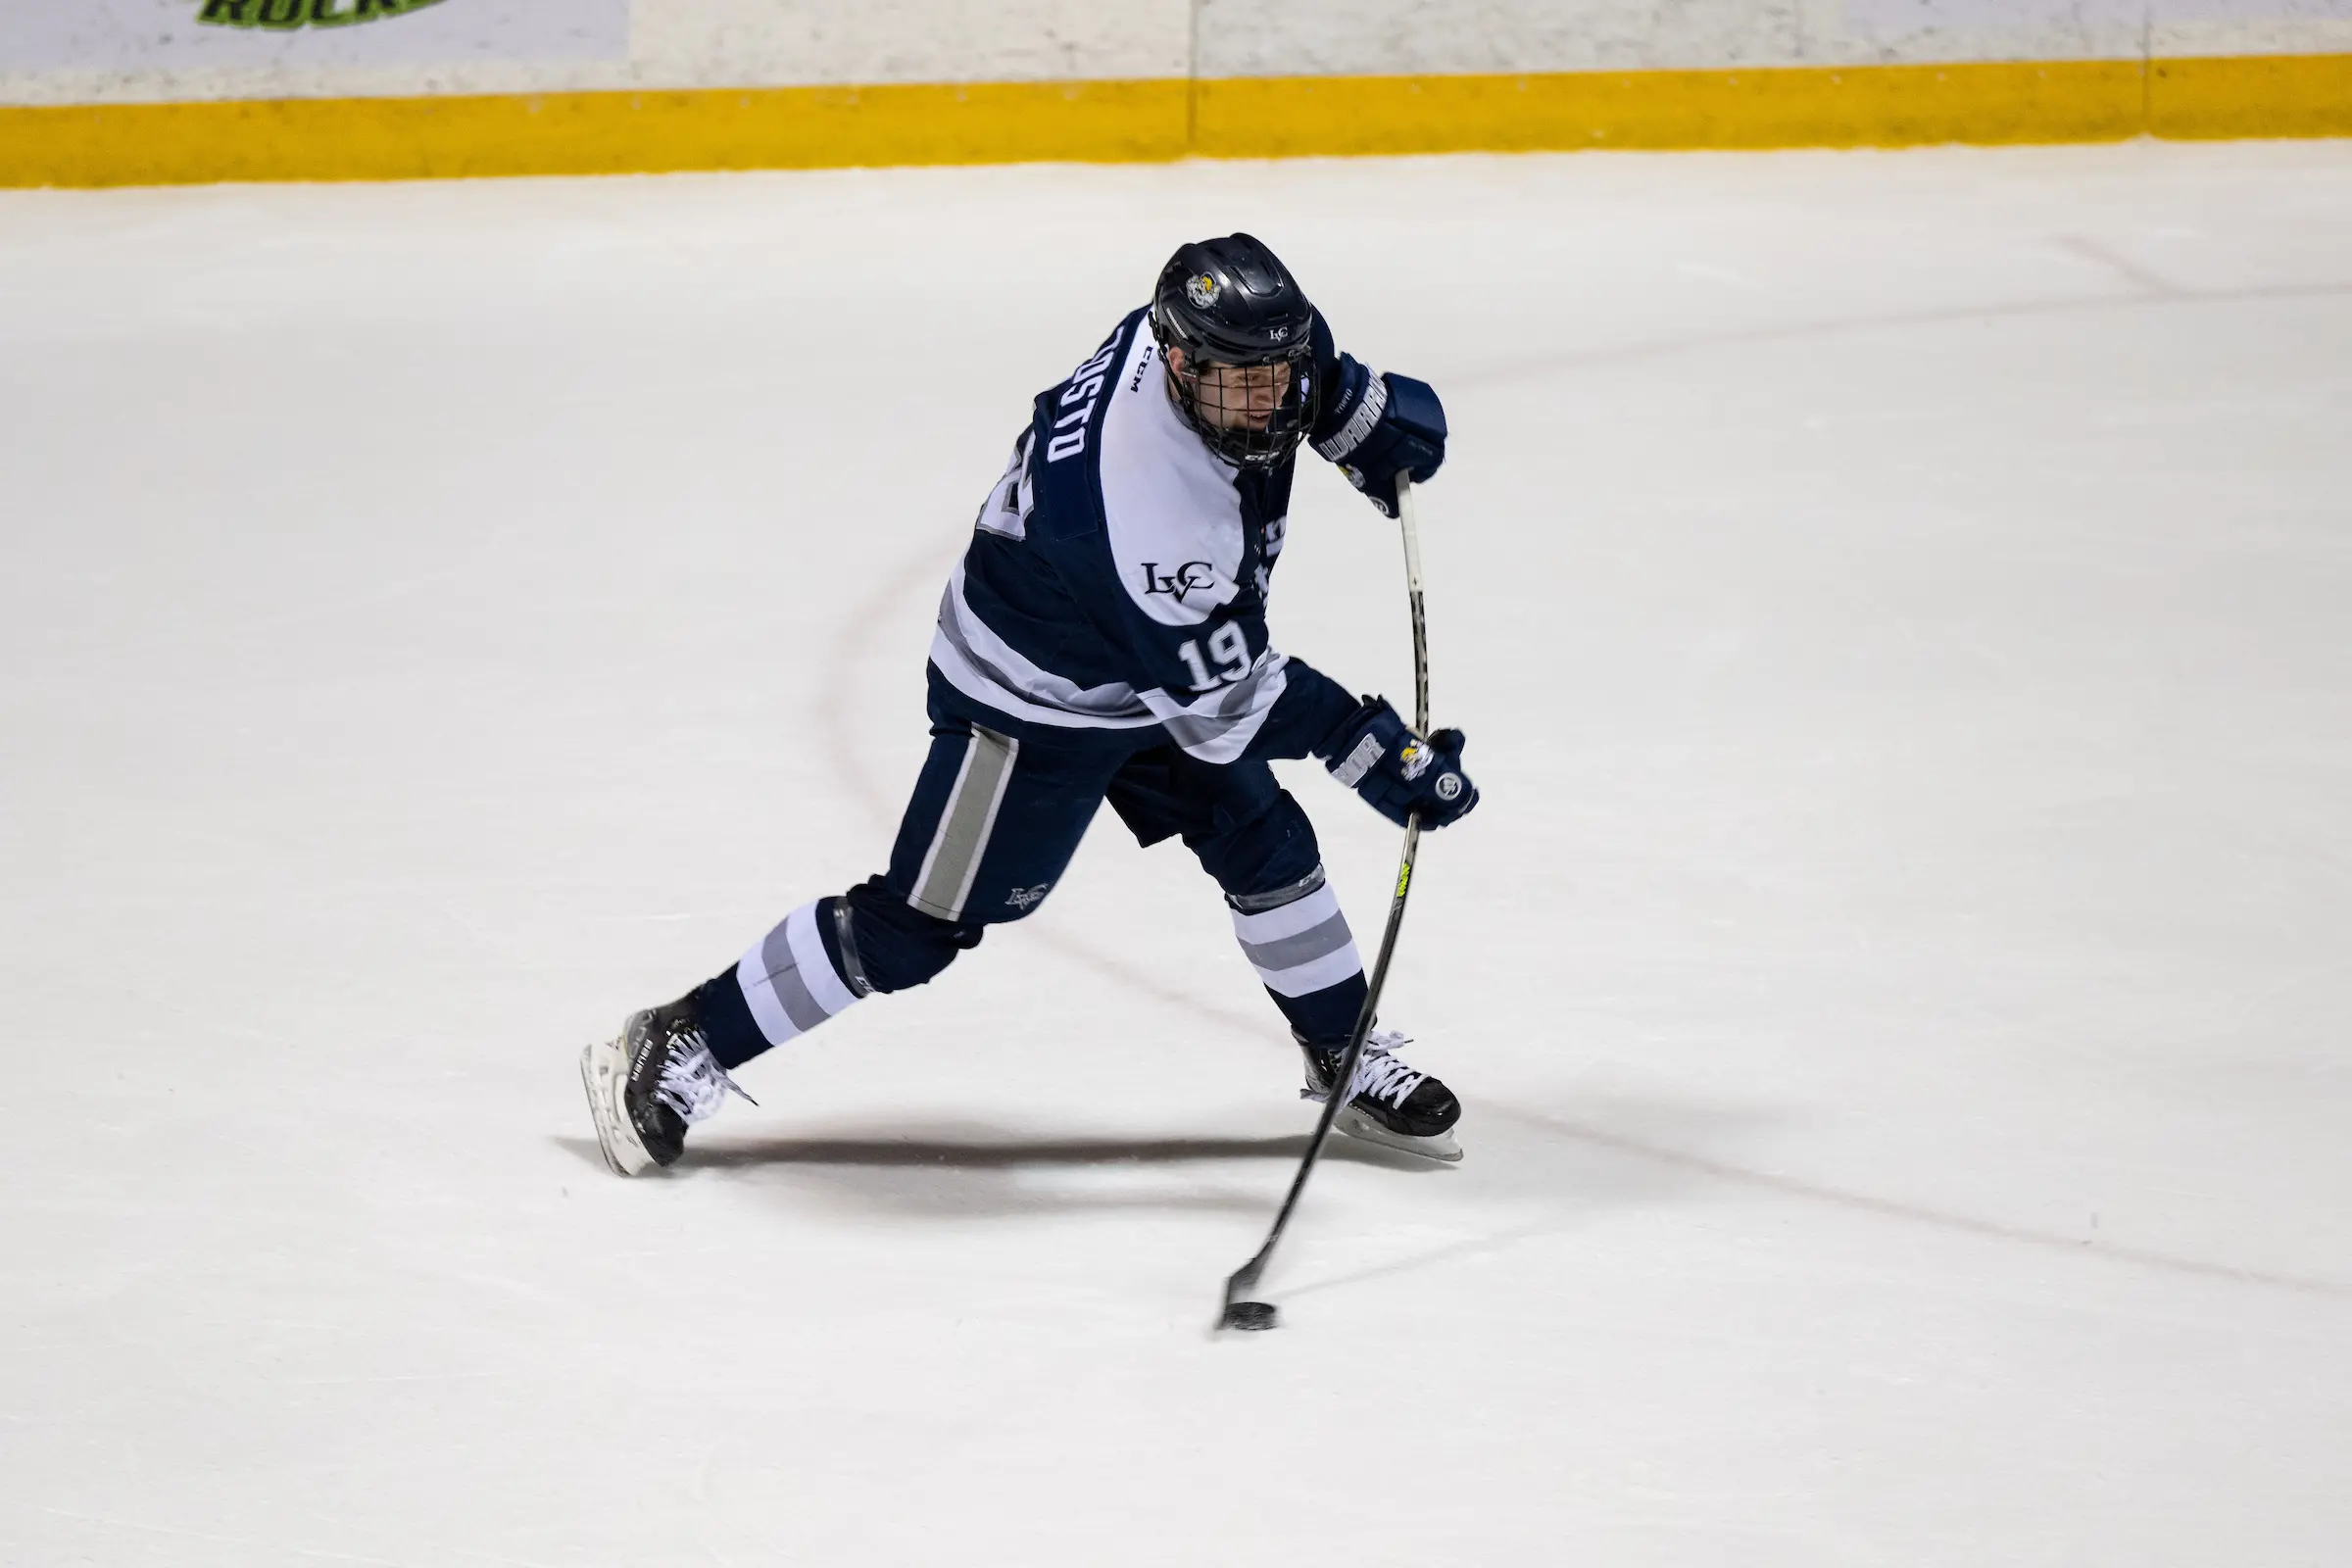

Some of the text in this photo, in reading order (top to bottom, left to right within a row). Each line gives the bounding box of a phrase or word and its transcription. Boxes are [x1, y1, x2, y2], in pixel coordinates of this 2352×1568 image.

[1270, 326, 1289, 342] LVC
[1130, 345, 1154, 393] CCM
[1317, 364, 1388, 462] WARRI
[1141, 561, 1215, 604] LVC
[1178, 619, 1252, 692] 19
